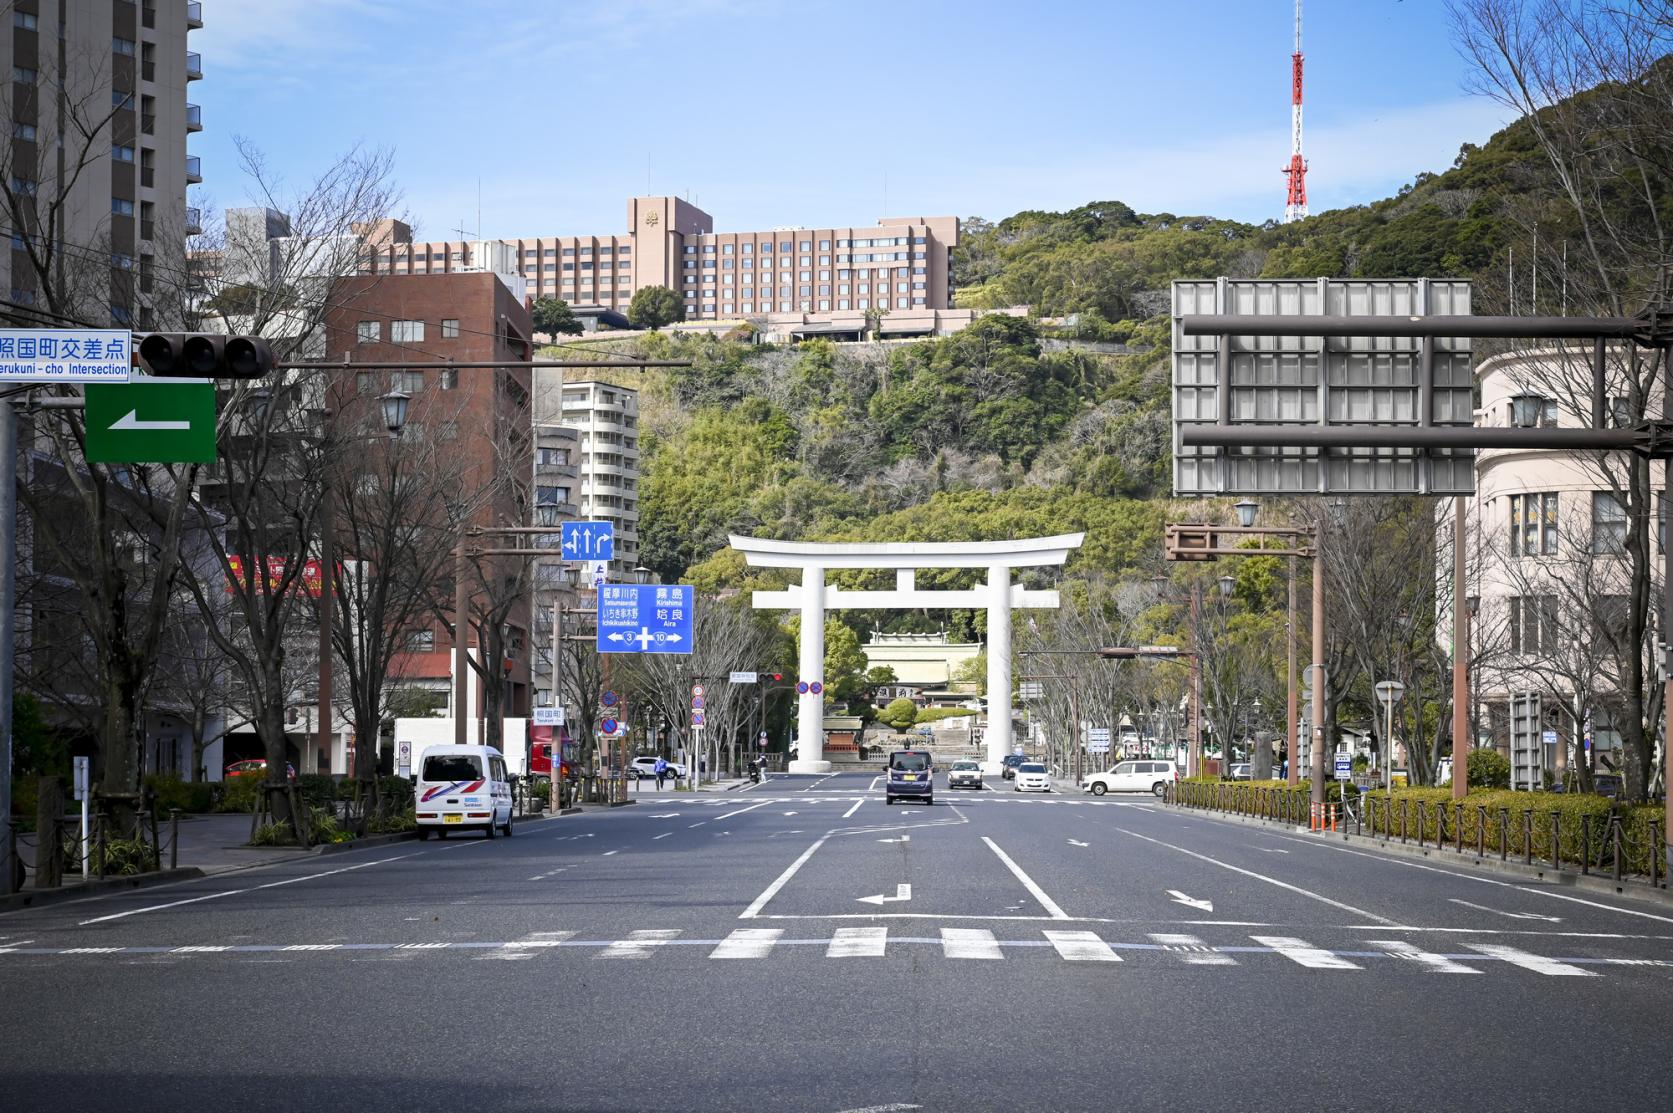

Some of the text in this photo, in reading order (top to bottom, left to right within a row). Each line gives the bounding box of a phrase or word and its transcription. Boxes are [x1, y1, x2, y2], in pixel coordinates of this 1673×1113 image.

[0, 338, 125, 360] 照国町交差点
[69, 363, 127, 375] Intersection
[656, 609, 683, 620] 姶良
[626, 633, 632, 641] 3
